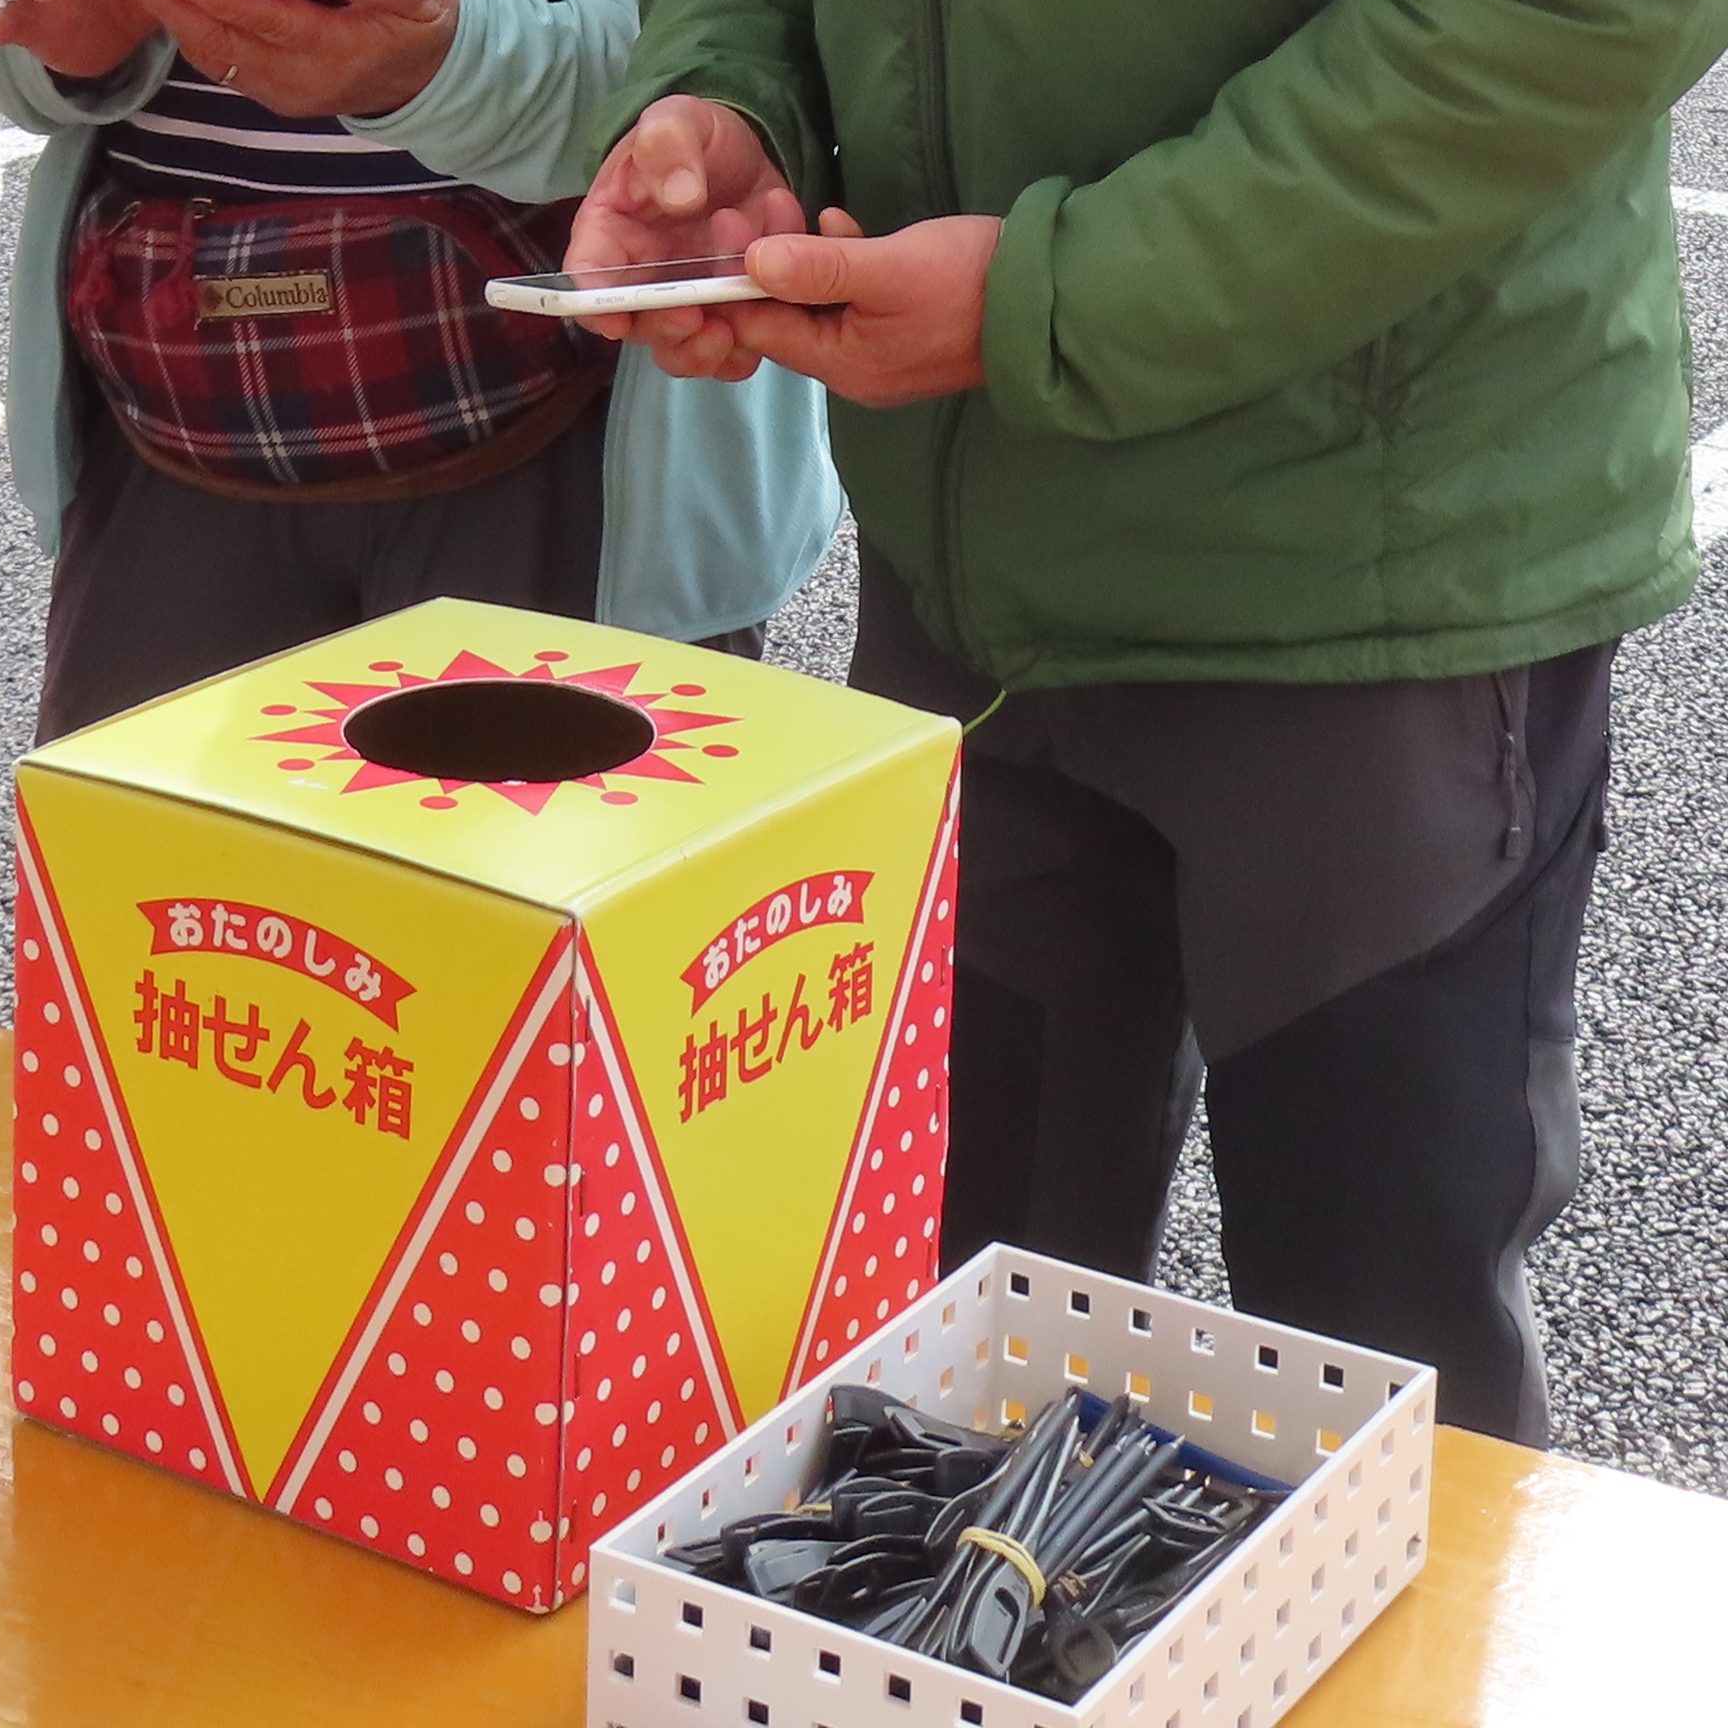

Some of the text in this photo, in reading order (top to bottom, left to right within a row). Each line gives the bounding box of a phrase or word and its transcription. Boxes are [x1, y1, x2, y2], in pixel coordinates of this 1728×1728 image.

[226, 282, 328, 309] Columbia
[166, 901, 385, 1003] おたのしみ
[702, 874, 854, 991] おたのしみ
[133, 968, 416, 1140] 抽せん箱
[676, 941, 876, 1125] 抽せん箱
